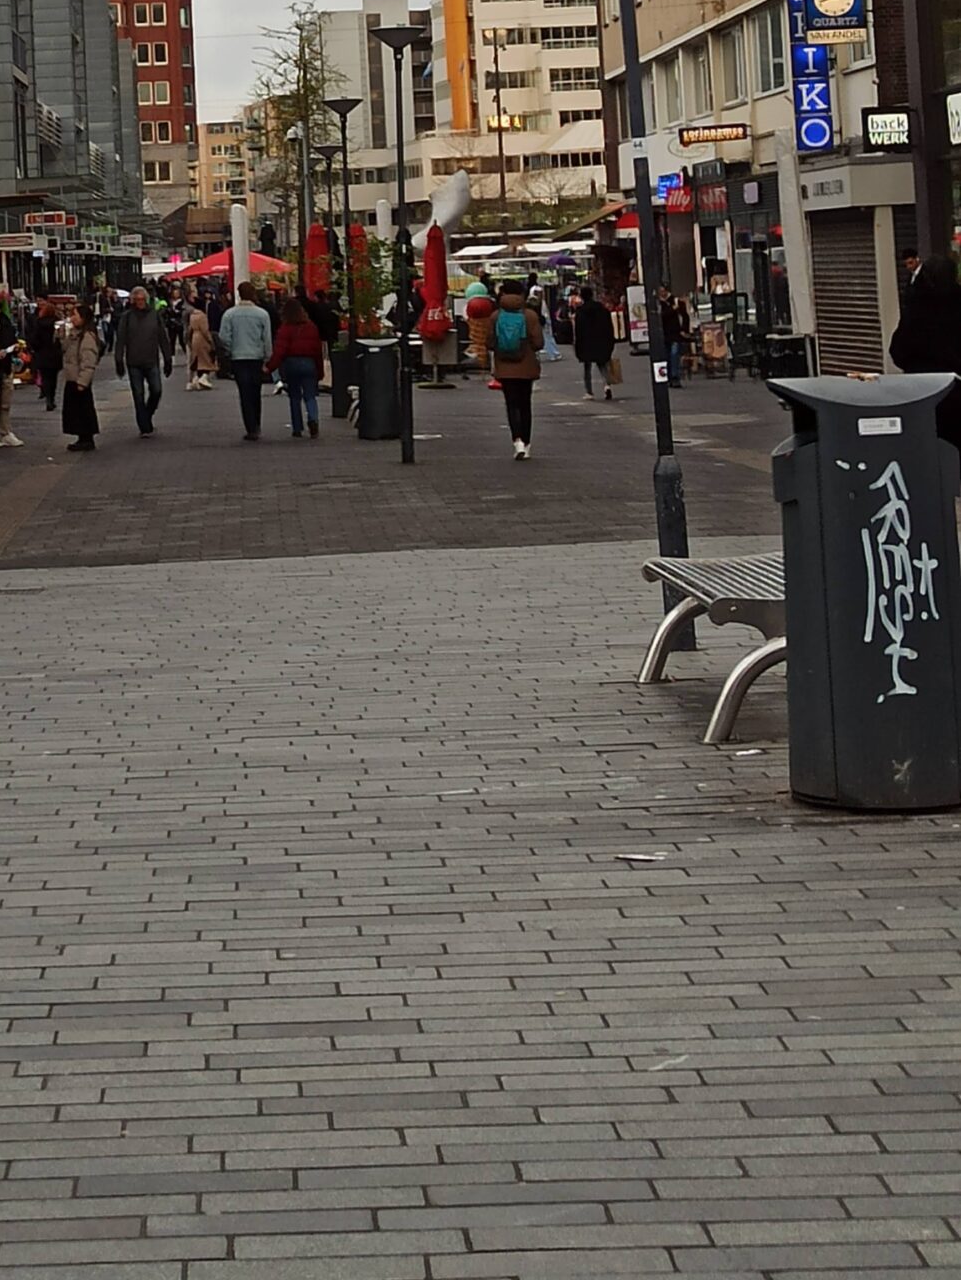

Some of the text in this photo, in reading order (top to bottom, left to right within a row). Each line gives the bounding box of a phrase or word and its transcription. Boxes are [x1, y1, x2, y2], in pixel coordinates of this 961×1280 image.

[812, 16, 859, 27] QUARTZ
[810, 29, 864, 40] VAN ANDEL
[870, 116, 905, 130] back
[869, 131, 909, 145] WERK
[668, 189, 691, 211] illy
